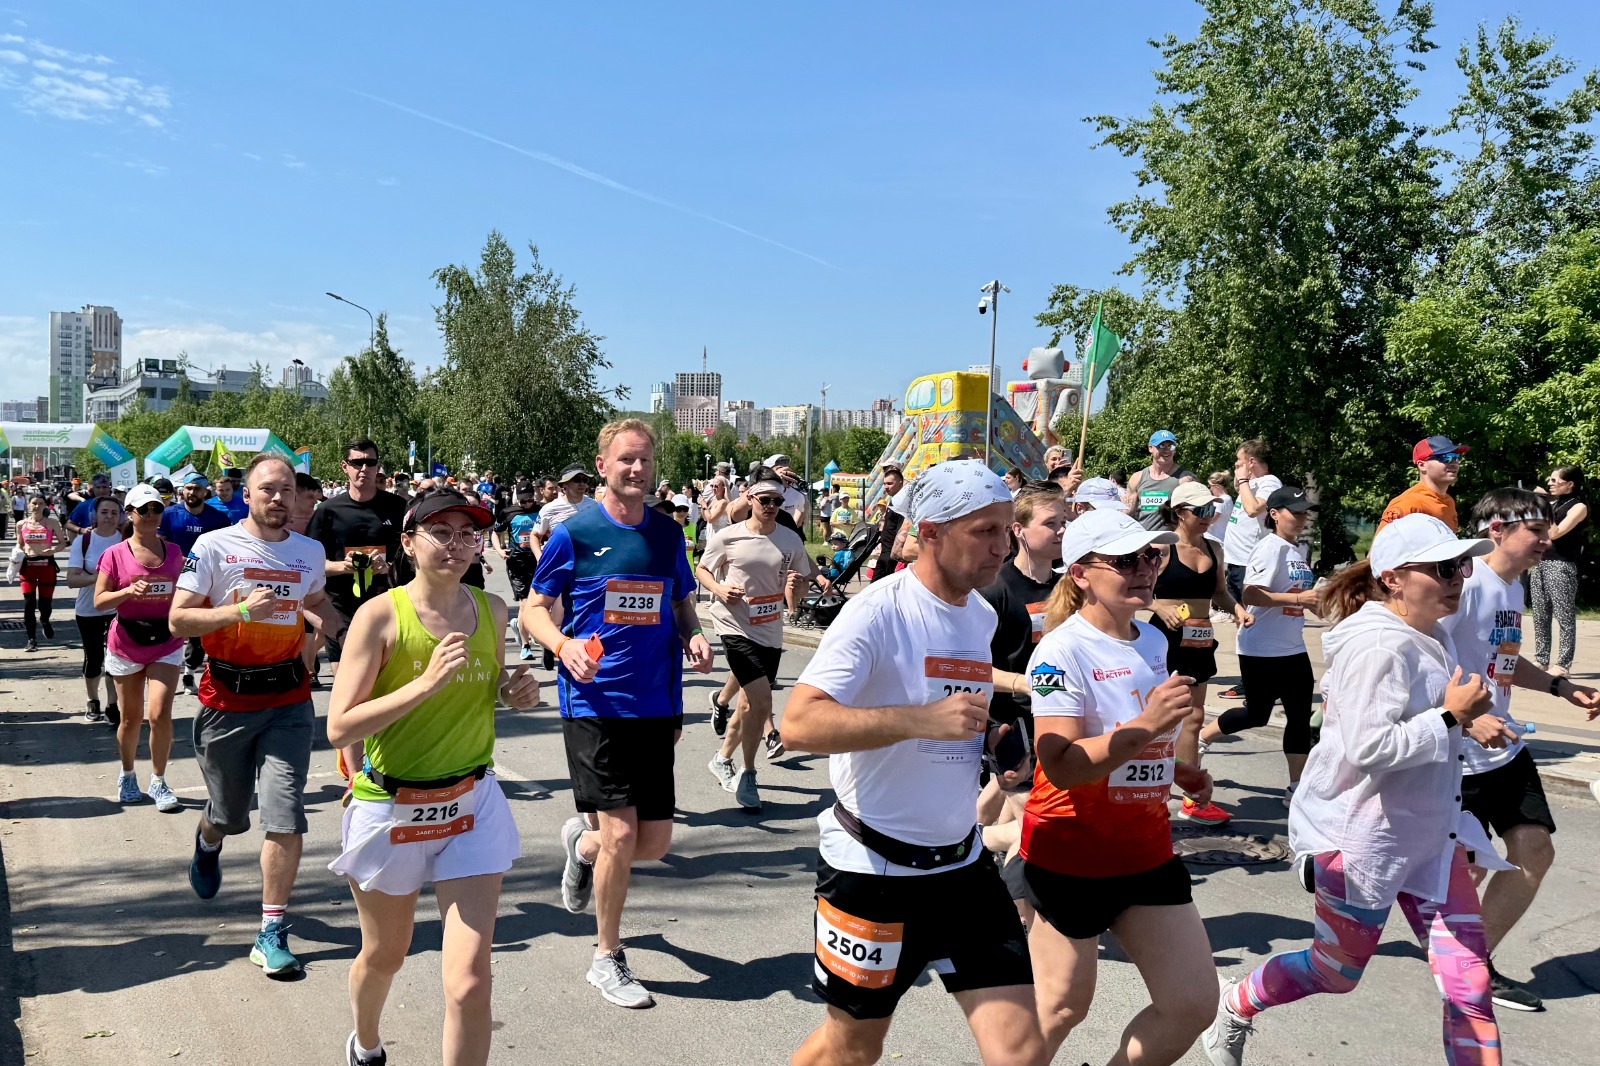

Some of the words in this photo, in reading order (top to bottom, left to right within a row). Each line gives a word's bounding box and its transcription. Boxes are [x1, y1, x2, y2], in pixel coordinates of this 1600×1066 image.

[200, 434, 257, 446] ФИНИШ
[94, 437, 122, 462] ФИНИШ
[151, 584, 166, 593] 32
[618, 596, 654, 609] 2238
[757, 604, 777, 615] 2234
[413, 658, 482, 671] RIA
[1502, 658, 1515, 671] 25
[413, 671, 491, 683] NING
[1032, 673, 1064, 687] БХЛ
[1105, 669, 1132, 679] АСТРУМ
[1125, 764, 1164, 782] 2512
[411, 802, 459, 822] 2216
[827, 929, 882, 965] 2504
[830, 961, 848, 973] ЗАБЕГ
